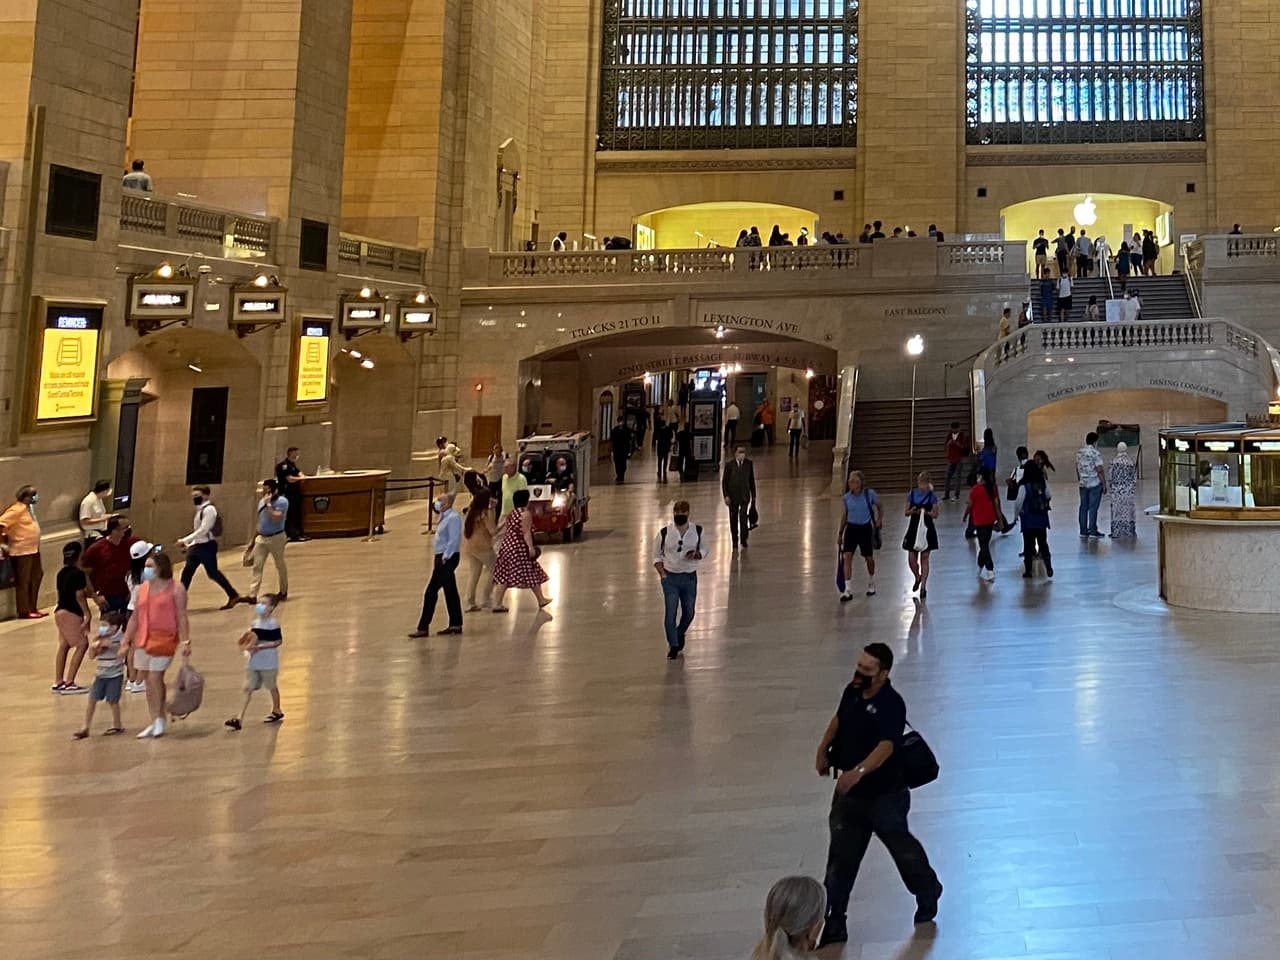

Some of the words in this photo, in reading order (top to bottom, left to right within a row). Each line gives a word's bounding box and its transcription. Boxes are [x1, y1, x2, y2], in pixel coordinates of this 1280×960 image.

[907, 307, 946, 316] BALCONY
[703, 313, 773, 329] LEXINGTON
[569, 321, 616, 339] TRACKS
[632, 316, 649, 327] TO
[1149, 378, 1179, 387] DINING
